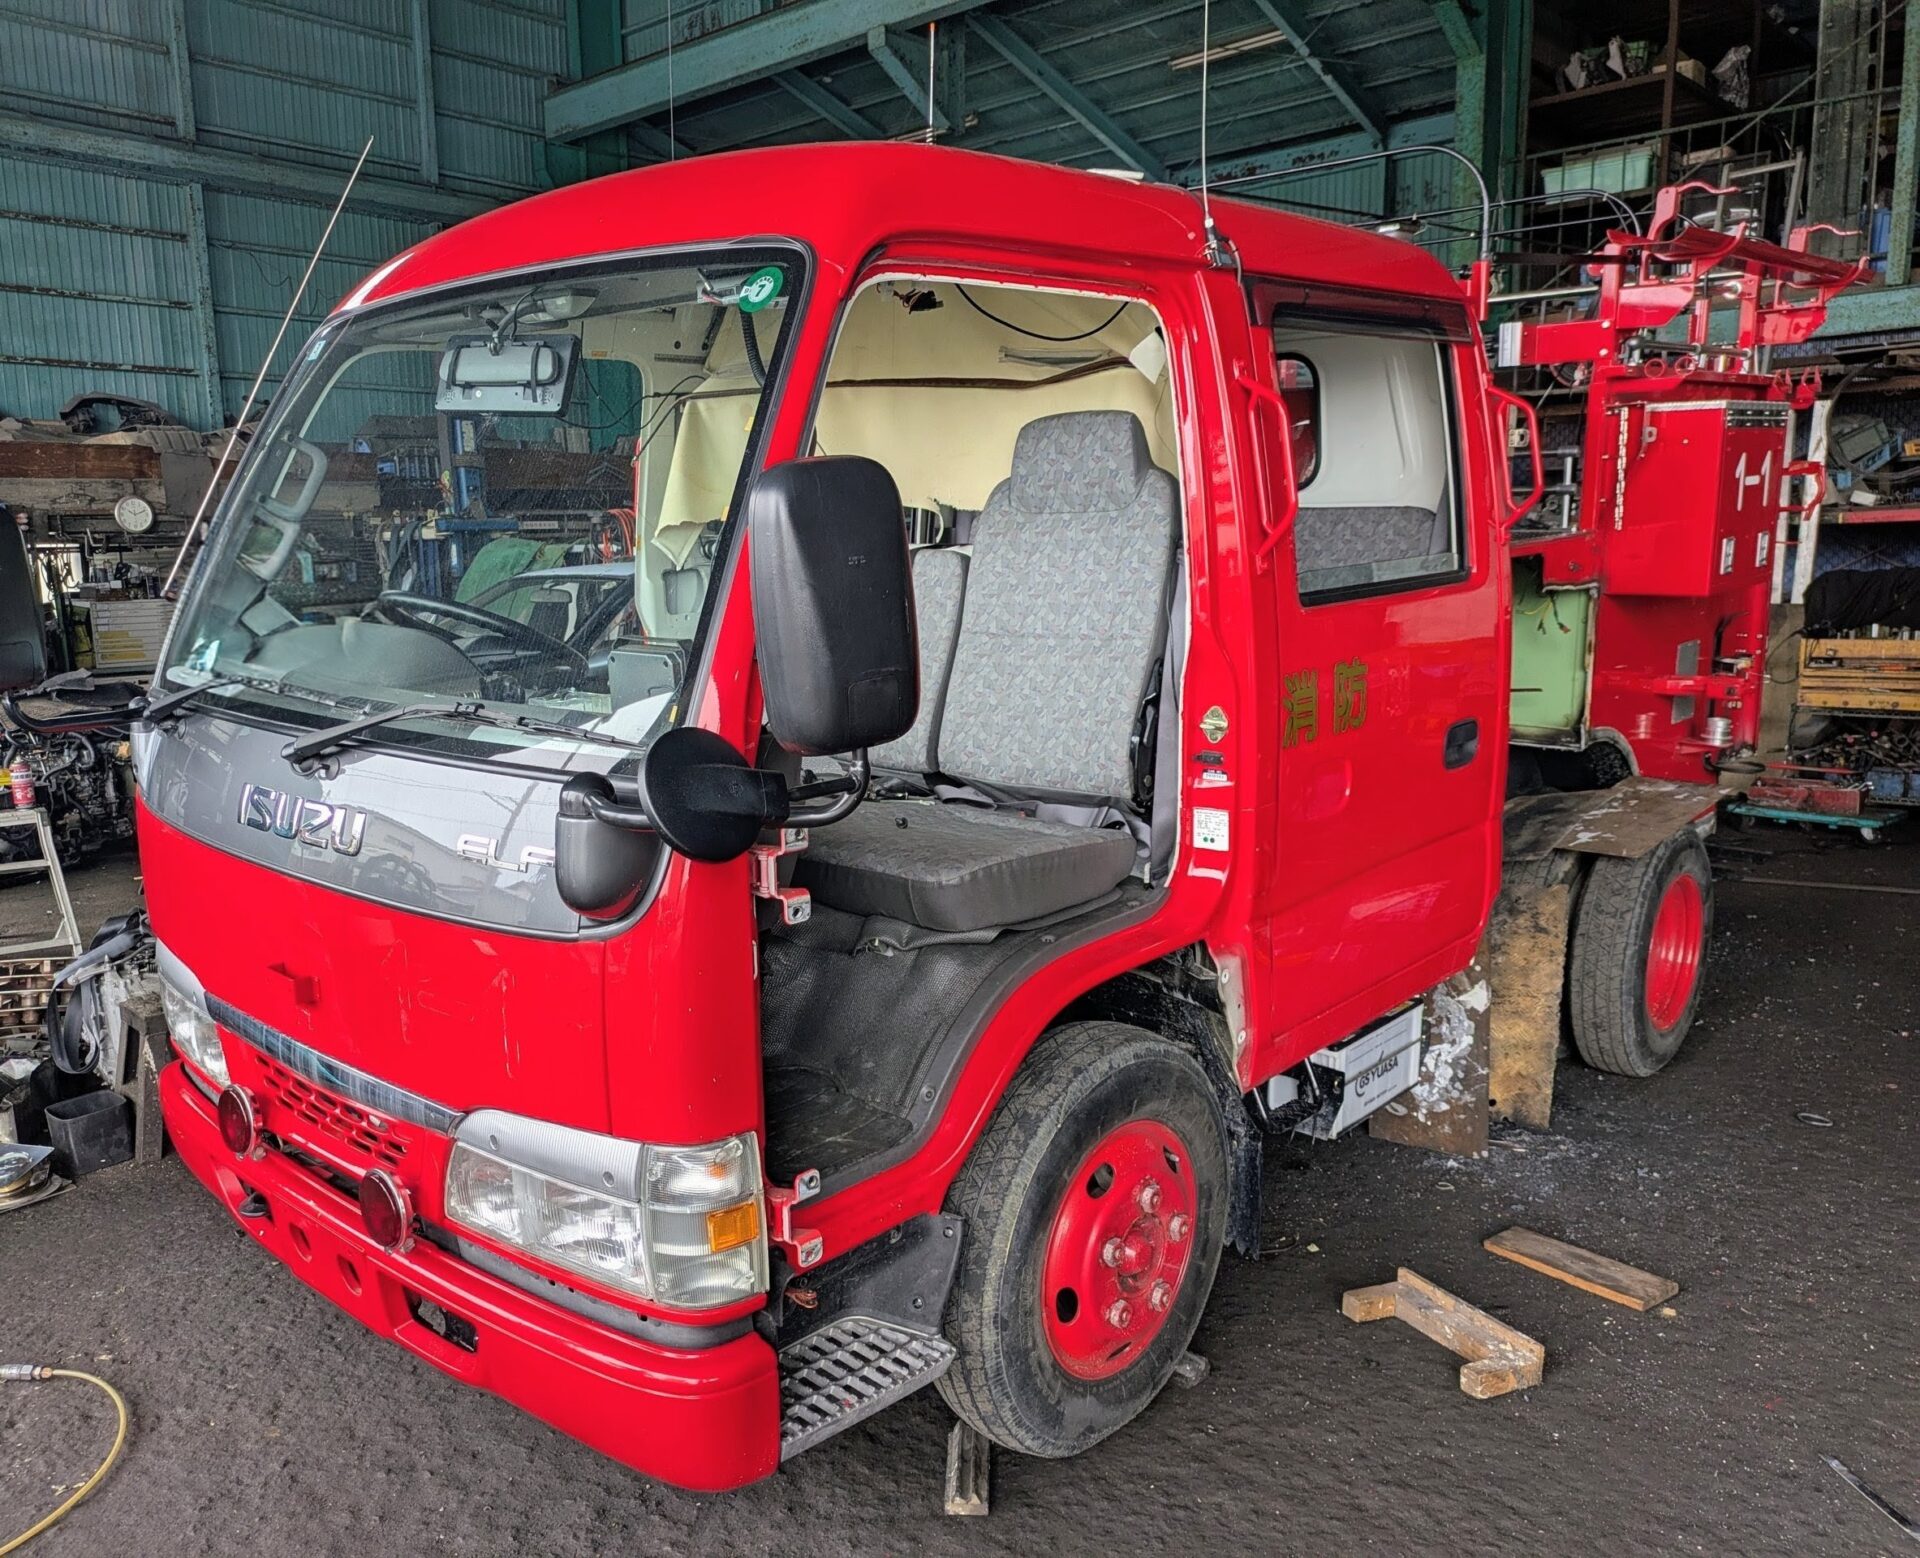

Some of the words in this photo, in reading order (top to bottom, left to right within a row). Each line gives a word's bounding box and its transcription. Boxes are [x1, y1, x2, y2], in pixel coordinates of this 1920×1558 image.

[754, 284, 766, 297] 7
[1735, 450, 1772, 512] 1-1
[1282, 657, 1367, 749] 消防
[238, 783, 366, 857] ISUZU
